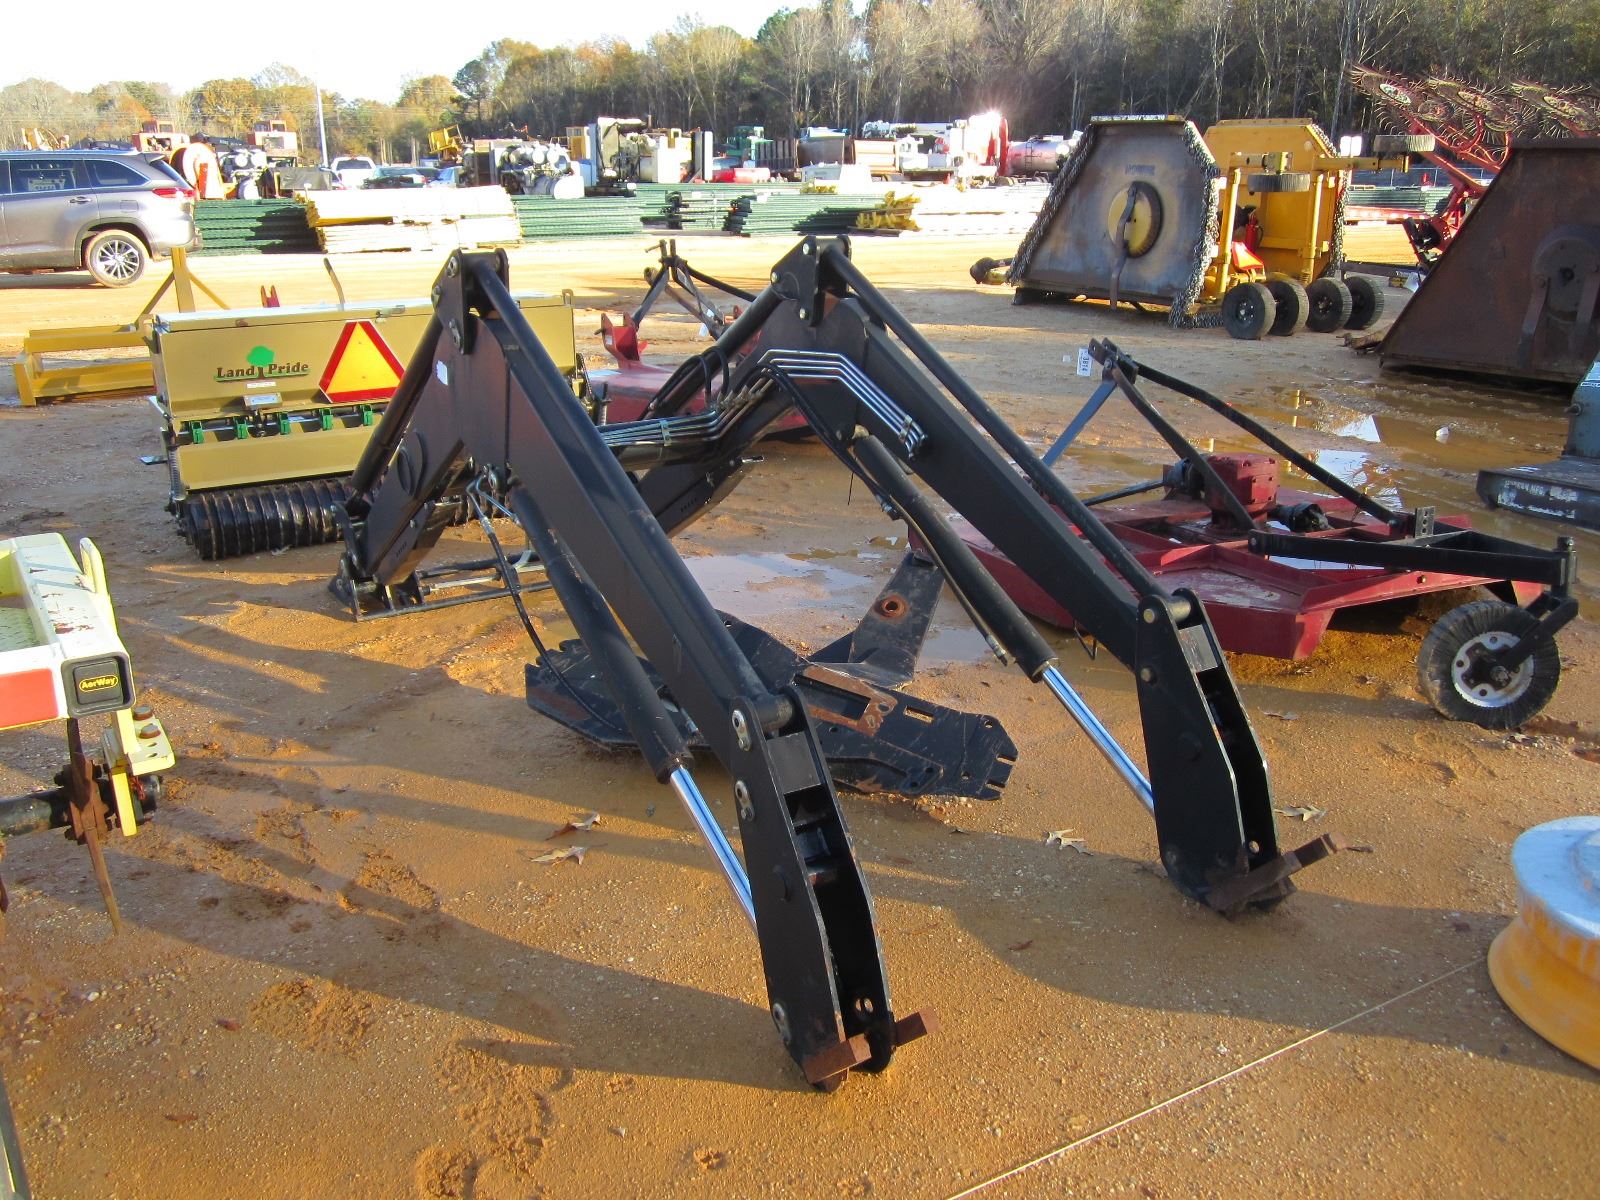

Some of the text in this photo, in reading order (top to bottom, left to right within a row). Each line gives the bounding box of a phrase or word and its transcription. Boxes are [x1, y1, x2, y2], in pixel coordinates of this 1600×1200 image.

[216, 361, 309, 379] Land Pride
[81, 677, 117, 689] AerWay
